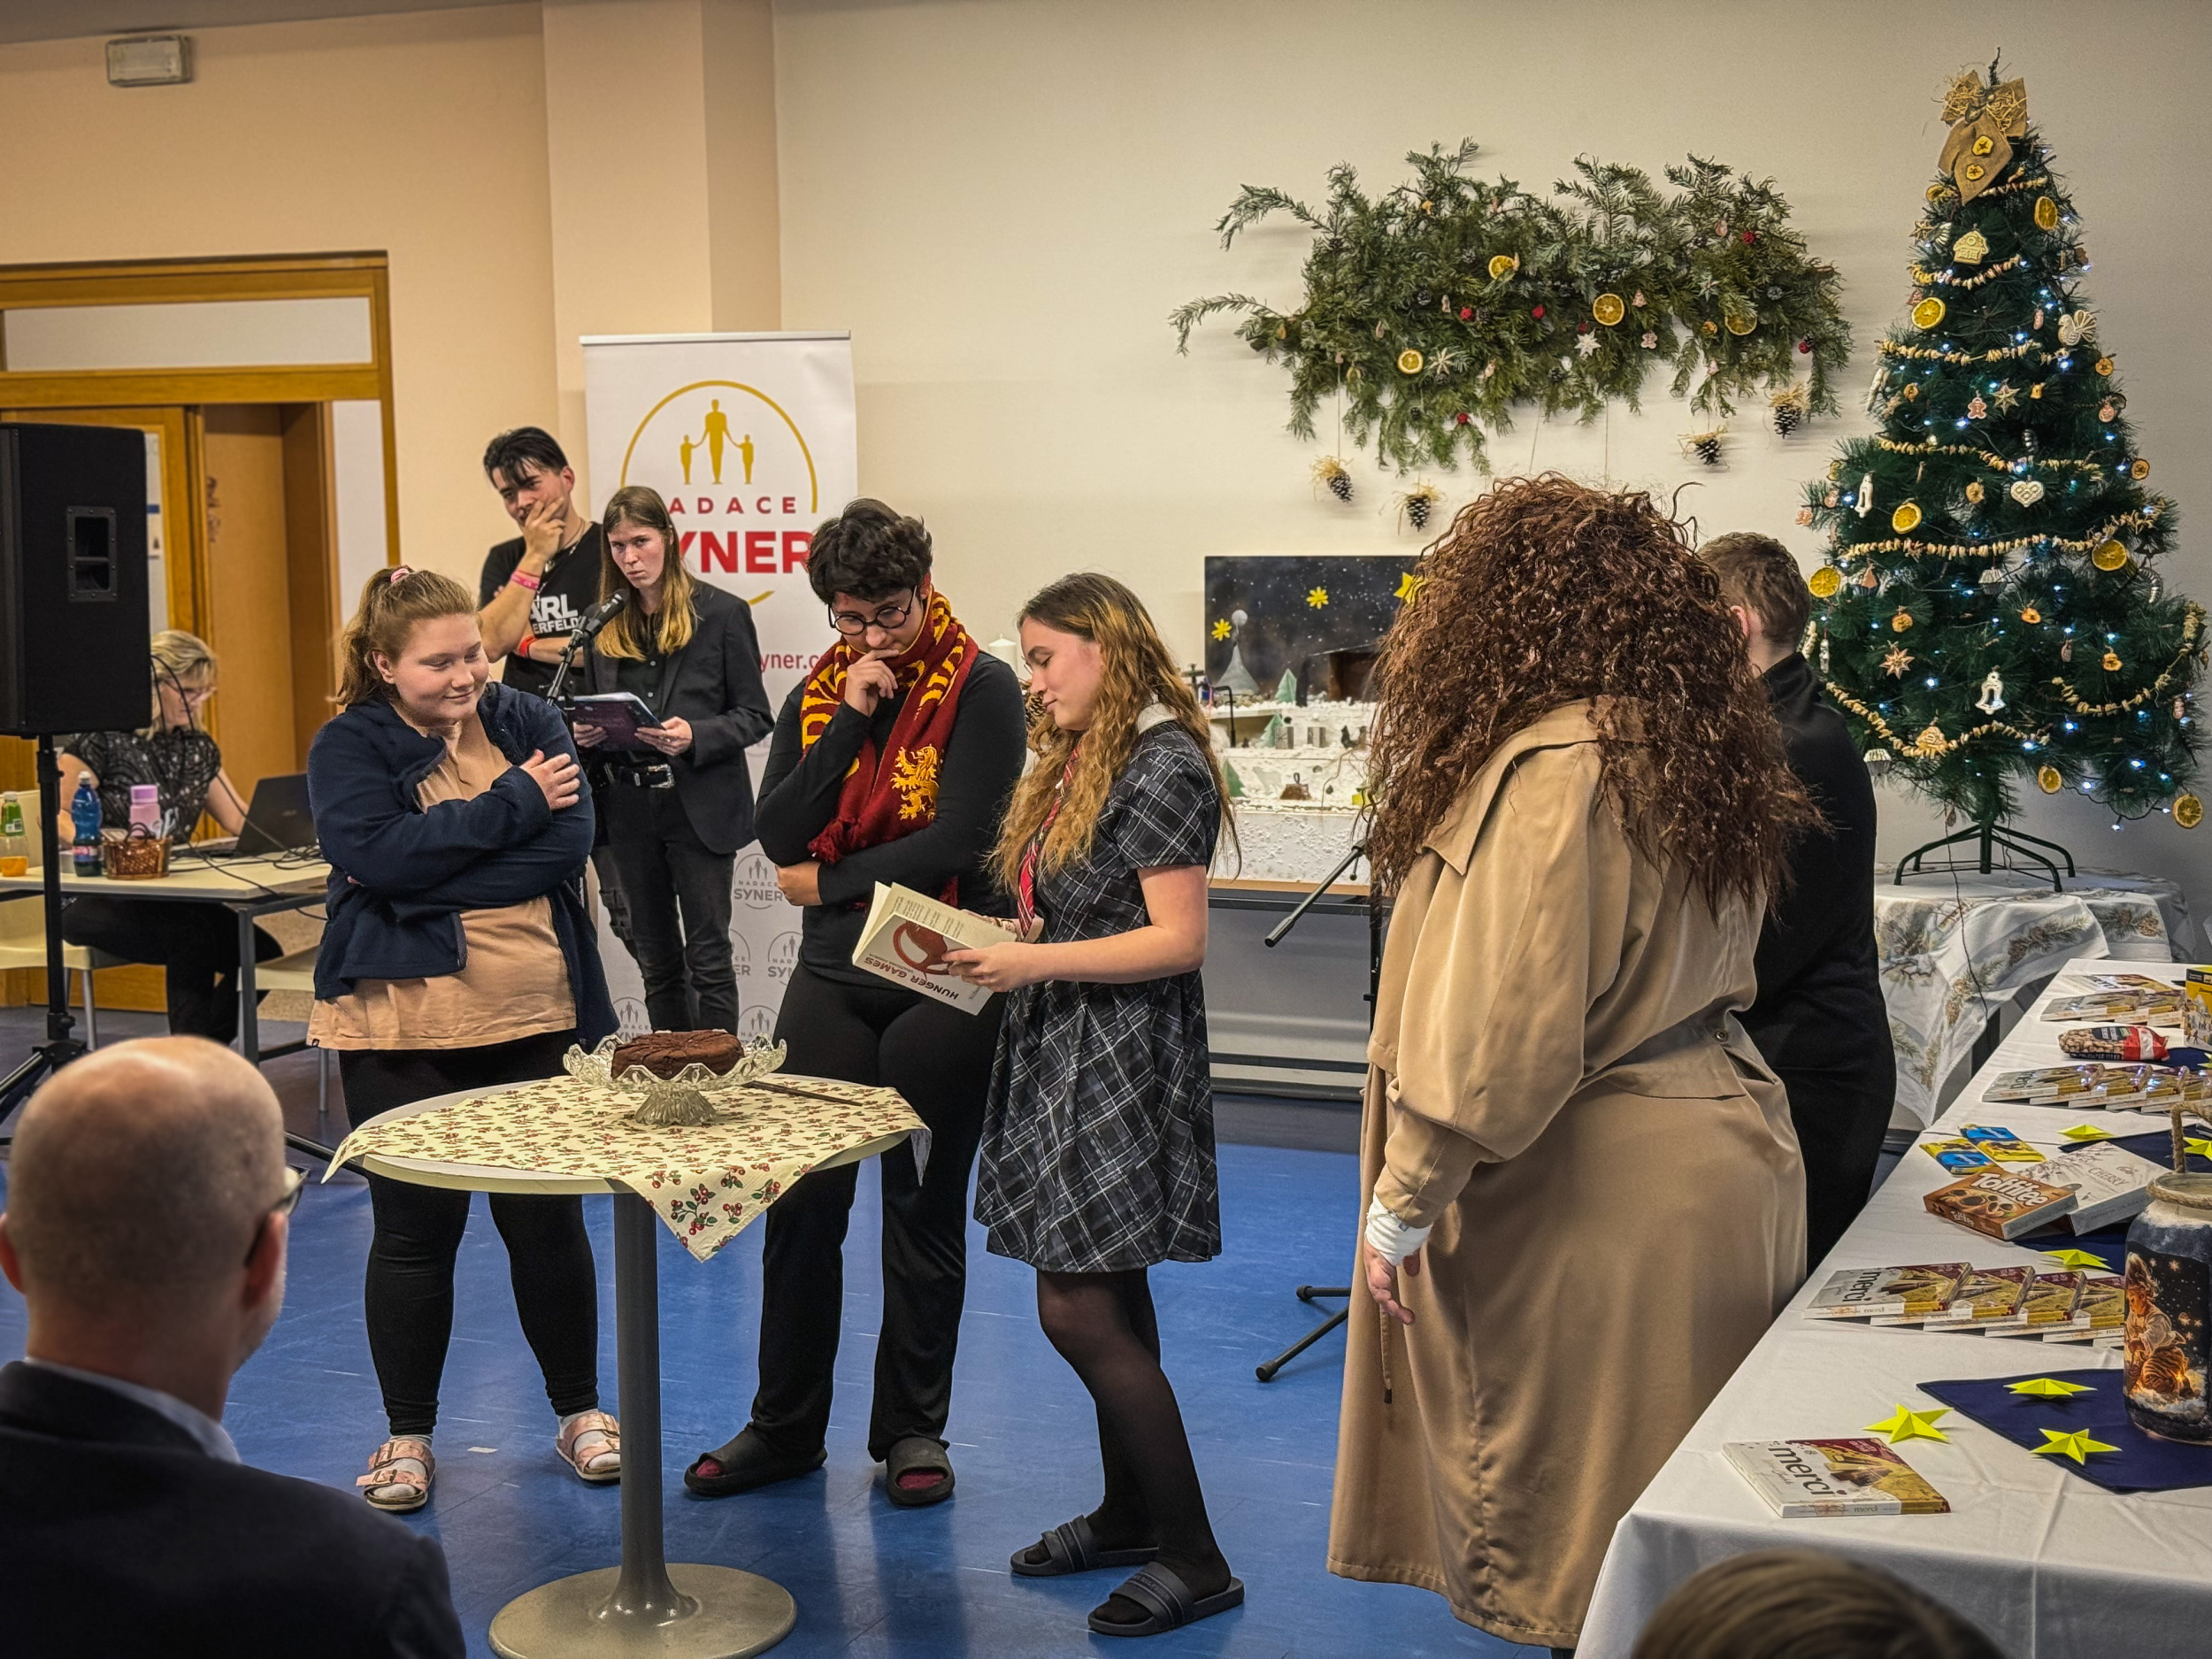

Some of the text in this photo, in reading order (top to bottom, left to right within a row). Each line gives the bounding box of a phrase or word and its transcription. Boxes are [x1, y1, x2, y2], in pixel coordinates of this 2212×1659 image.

[669, 496, 796, 514] ADACE
[680, 531, 814, 573] NER
[530, 594, 579, 622] ARL
[533, 617, 580, 634] ERFELD
[761, 652, 821, 673] yner.c
[733, 887, 783, 902] SYNER
[2088, 1167, 2131, 1187] CHERRY
[1970, 1172, 2050, 1207] Toffifee
[1842, 1271, 1883, 1302] merci
[1768, 1447, 1847, 1495] merci
